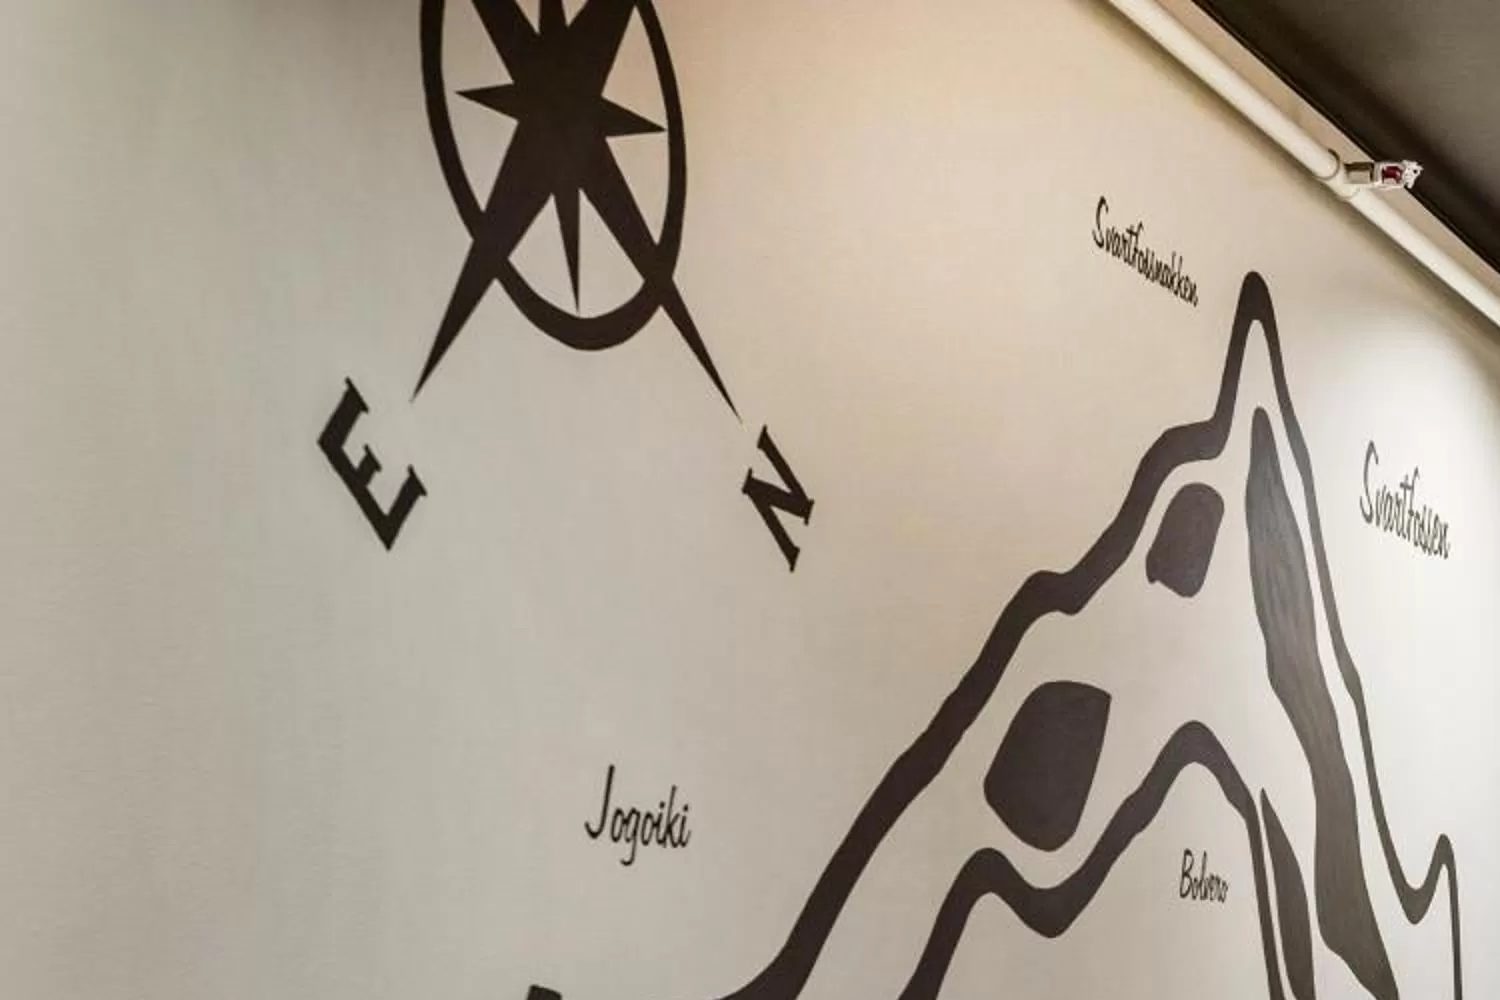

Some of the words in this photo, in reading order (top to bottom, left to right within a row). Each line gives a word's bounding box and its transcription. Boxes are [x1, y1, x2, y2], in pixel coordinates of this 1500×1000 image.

[1091, 195, 1199, 307] Svartfossnakken
[317, 376, 427, 552] E
[740, 424, 815, 573] N
[1360, 440, 1450, 560] Svartfossen
[584, 764, 692, 867] Jogoiki
